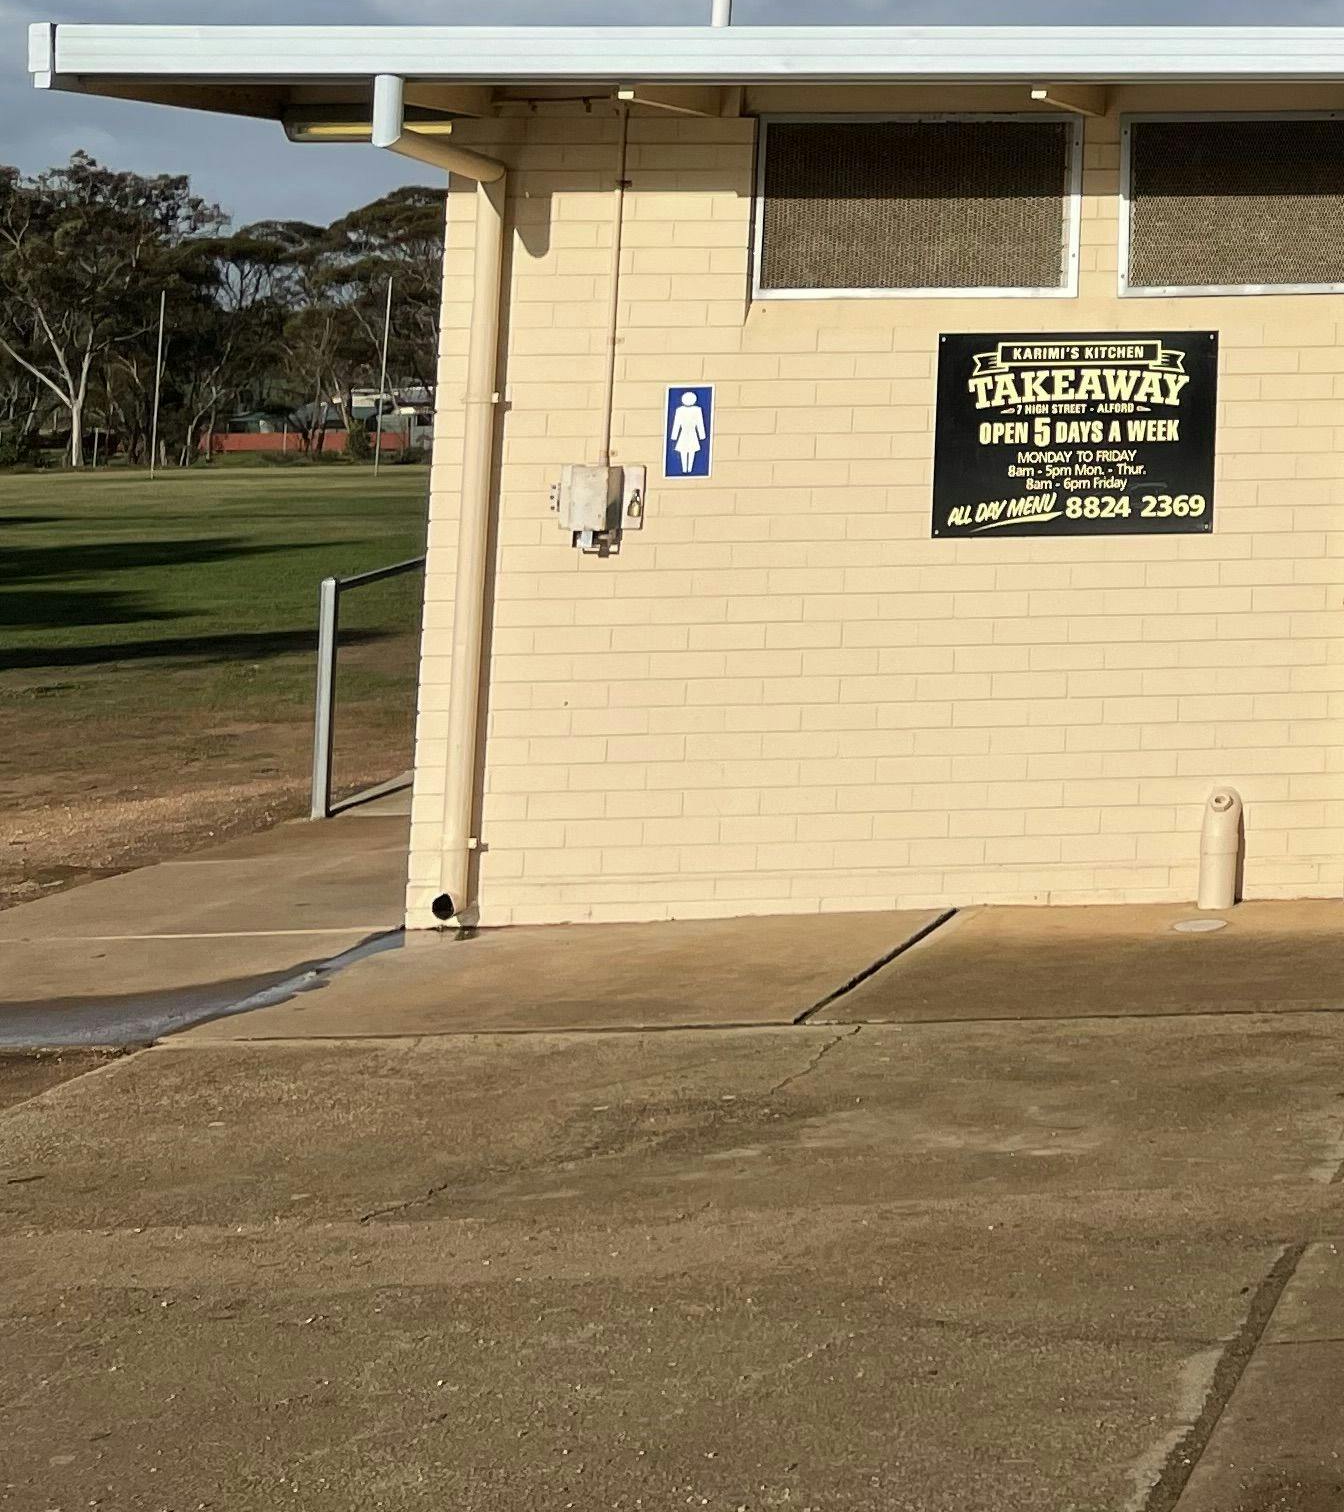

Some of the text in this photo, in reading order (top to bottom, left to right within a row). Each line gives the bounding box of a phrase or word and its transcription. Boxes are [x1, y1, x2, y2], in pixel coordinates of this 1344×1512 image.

[1013, 346, 1144, 360] KARIMI'S KITCHEN
[968, 369, 1190, 409] TAKEAWAY
[1017, 405, 1022, 414] 7
[1025, 404, 1048, 414] HIGH
[1052, 404, 1087, 413] STREET
[1097, 403, 1134, 413] ALFORD
[979, 417, 1179, 447] OPEN 5 DAYS A WEEK
[1018, 450, 1137, 463] MONDAY TO FRIDAY
[1008, 464, 1035, 476] 8am
[1045, 465, 1072, 479] 5pm
[1074, 464, 1105, 476] Mon.
[1117, 463, 1147, 475] Thur.
[1026, 478, 1052, 490] 8am
[1063, 477, 1091, 492] 6pm
[1093, 478, 1128, 491] Friday
[948, 492, 1206, 526] ALL DAY MENU 8824 2369
